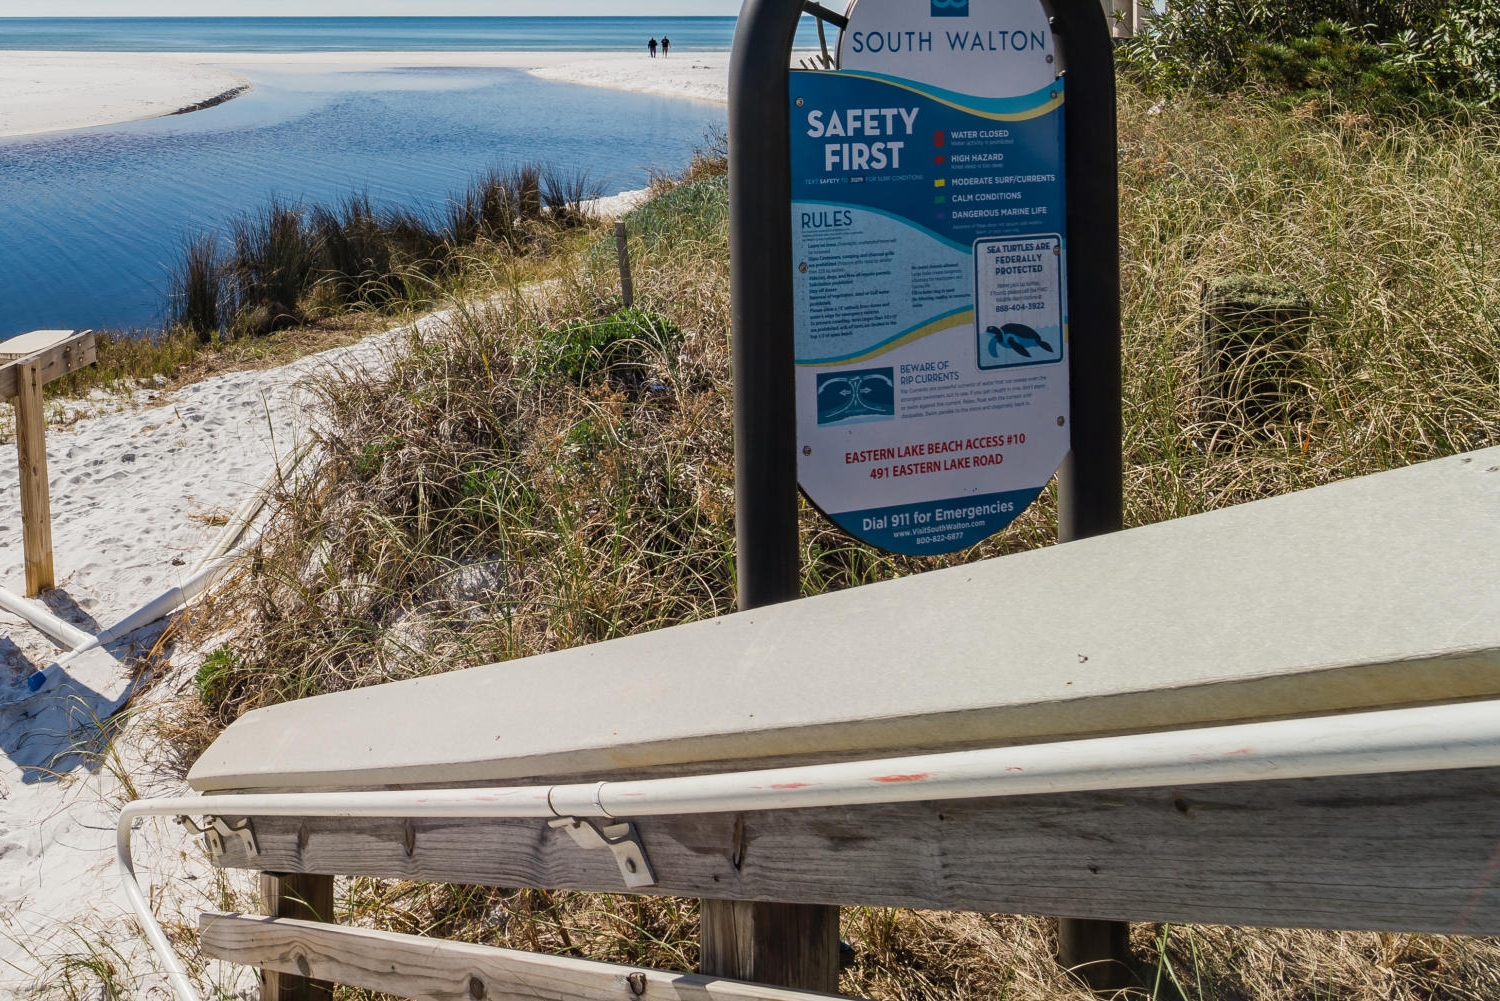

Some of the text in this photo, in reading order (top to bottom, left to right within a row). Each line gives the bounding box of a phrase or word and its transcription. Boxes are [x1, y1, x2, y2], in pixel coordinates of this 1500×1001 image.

[852, 30, 1045, 53] SOUTH WALTON
[807, 108, 920, 138] SAFETY
[980, 130, 1009, 138] CLOSED
[825, 142, 904, 171] FIRST
[952, 175, 1055, 186] MODERATE SURF/CURRENTS
[975, 192, 1021, 201] CONDITIONS
[802, 210, 852, 228] RULES
[952, 207, 1047, 219] DANGEROUS MARINE LIFE
[1003, 244, 1033, 252] TURTLES
[996, 254, 1042, 264] FEDERALLY
[996, 265, 1042, 275] PROTECTED
[900, 361, 949, 374] BEWARE OF
[901, 372, 960, 385] RIP CURRENTS
[845, 433, 1026, 464] EASTERN LAKE BEACH ACCESS #10
[870, 453, 1004, 479] 491 EASTERN LAKE ROAD
[862, 501, 1014, 531] Dial 911 for Emergencies
